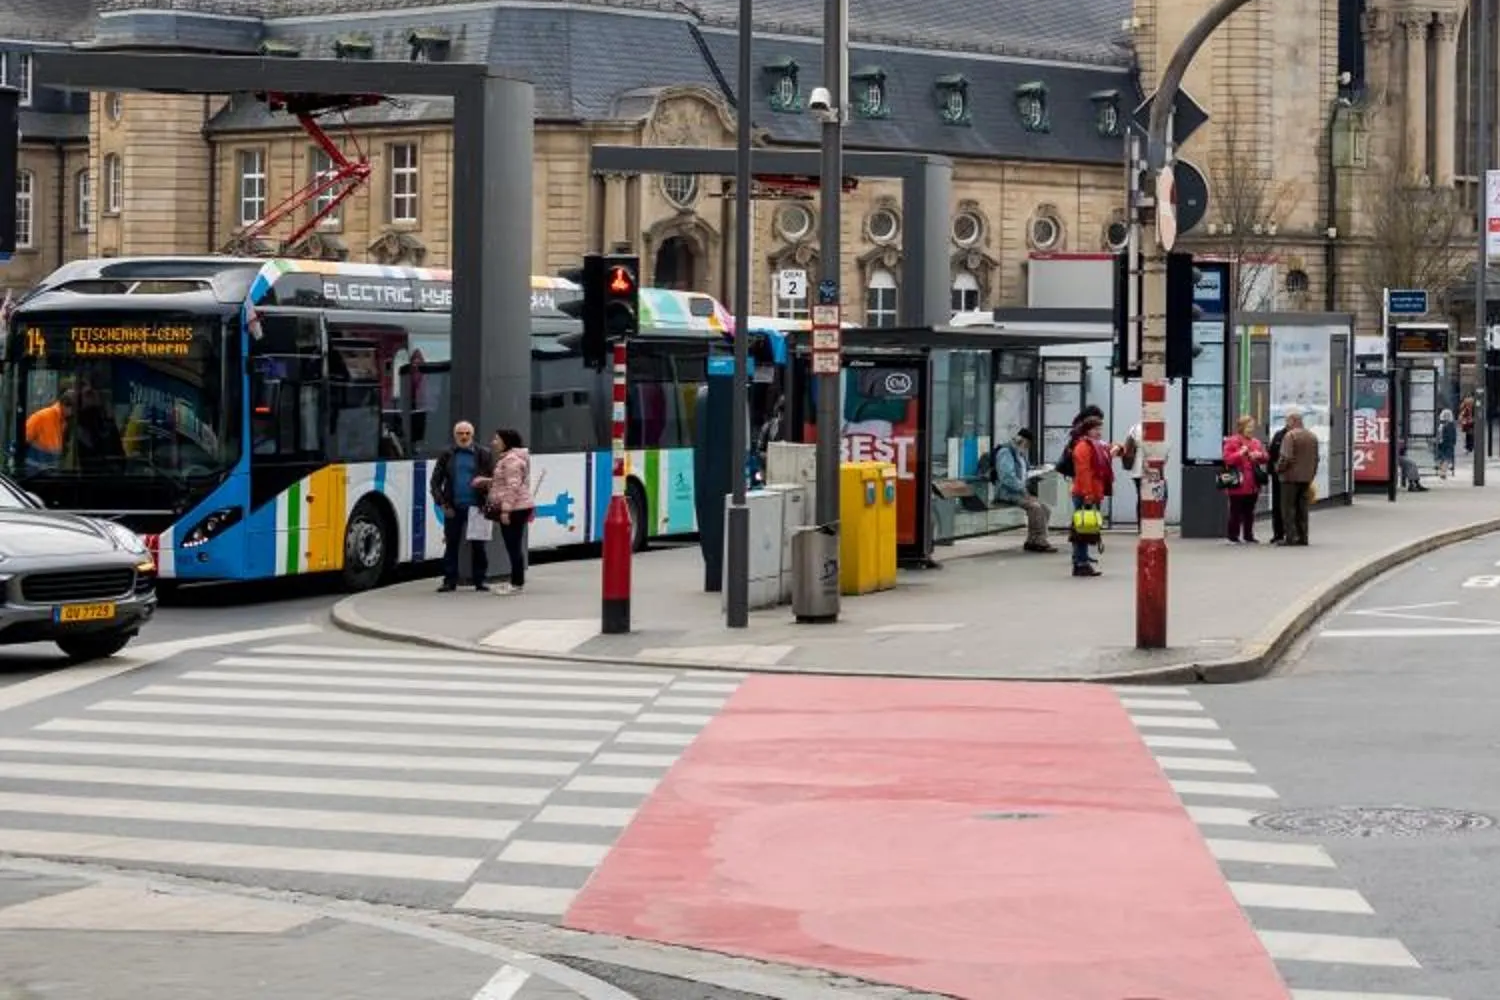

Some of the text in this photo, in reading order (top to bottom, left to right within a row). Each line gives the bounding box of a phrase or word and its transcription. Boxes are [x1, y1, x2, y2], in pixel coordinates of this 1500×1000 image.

[323, 283, 413, 303] ELECTRIC
[788, 281, 797, 294] 2
[26, 327, 45, 355] 14
